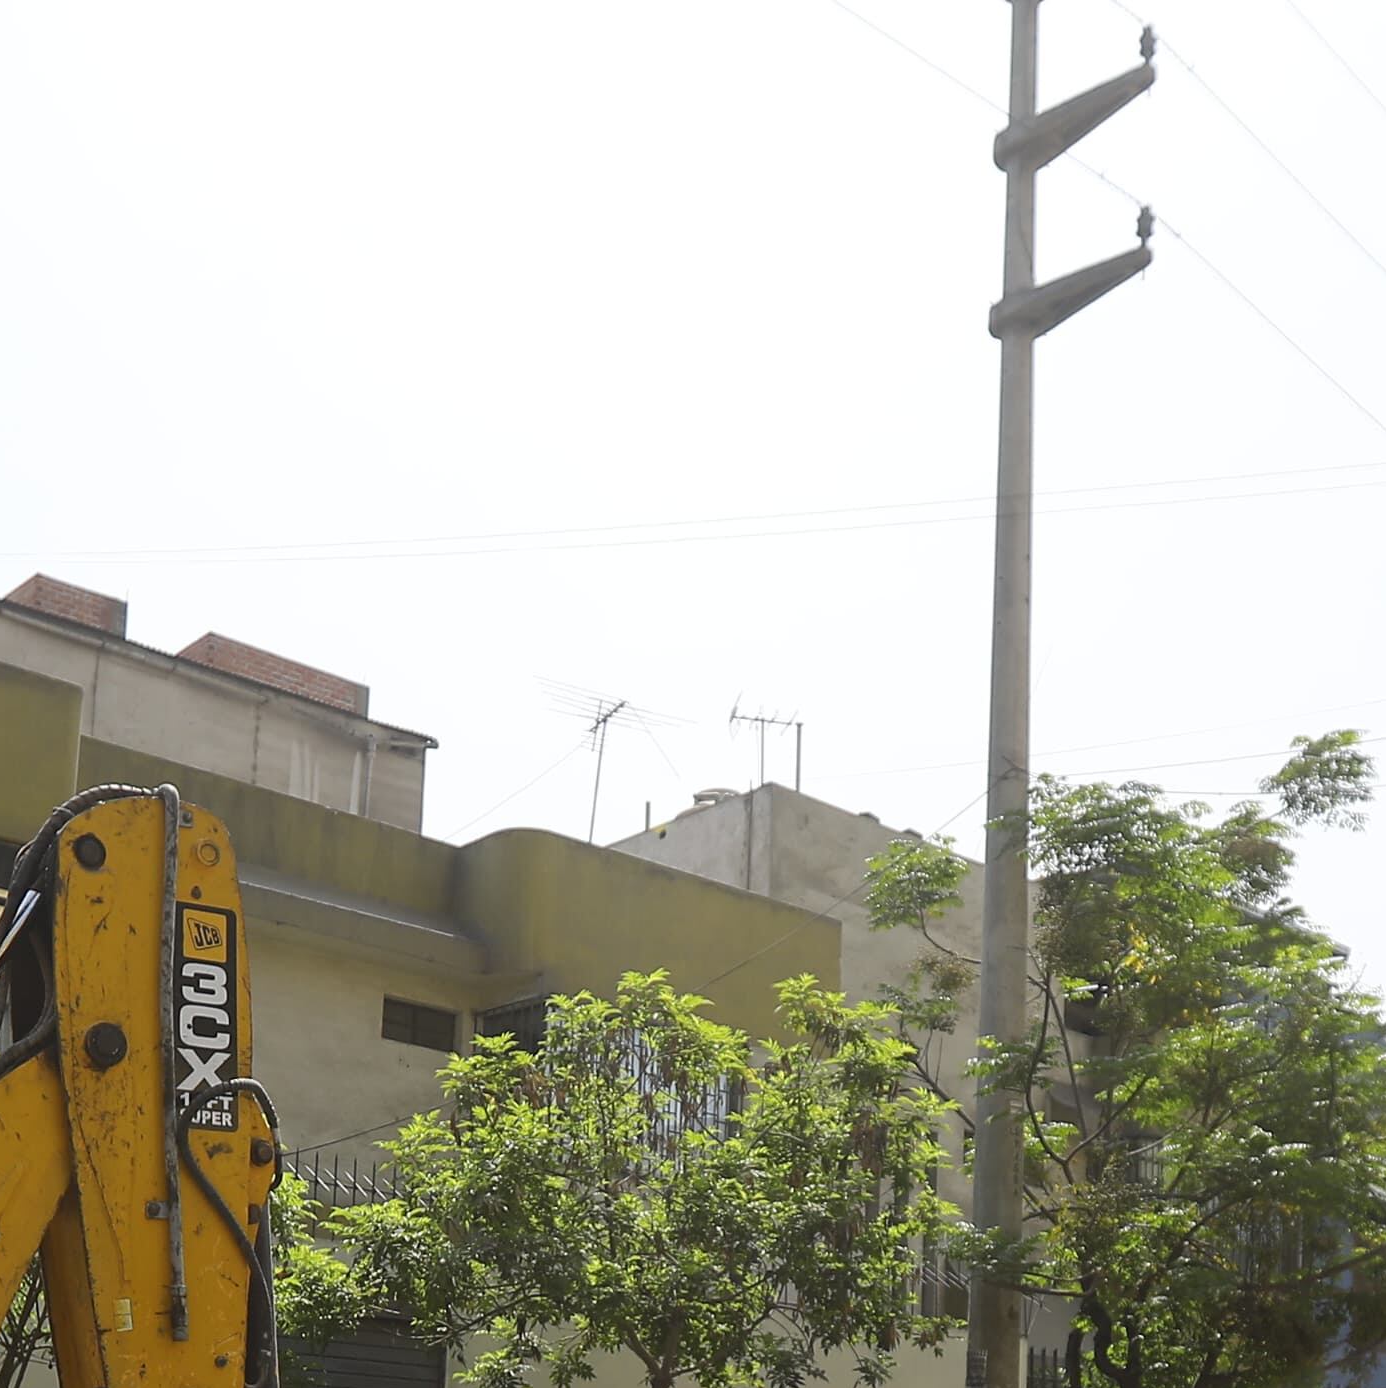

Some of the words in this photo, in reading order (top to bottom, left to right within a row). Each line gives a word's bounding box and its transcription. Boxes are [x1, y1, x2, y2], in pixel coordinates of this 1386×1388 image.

[193, 922, 220, 948] JCB
[177, 962, 232, 1091] 3CX
[179, 1107, 234, 1128] UPER
